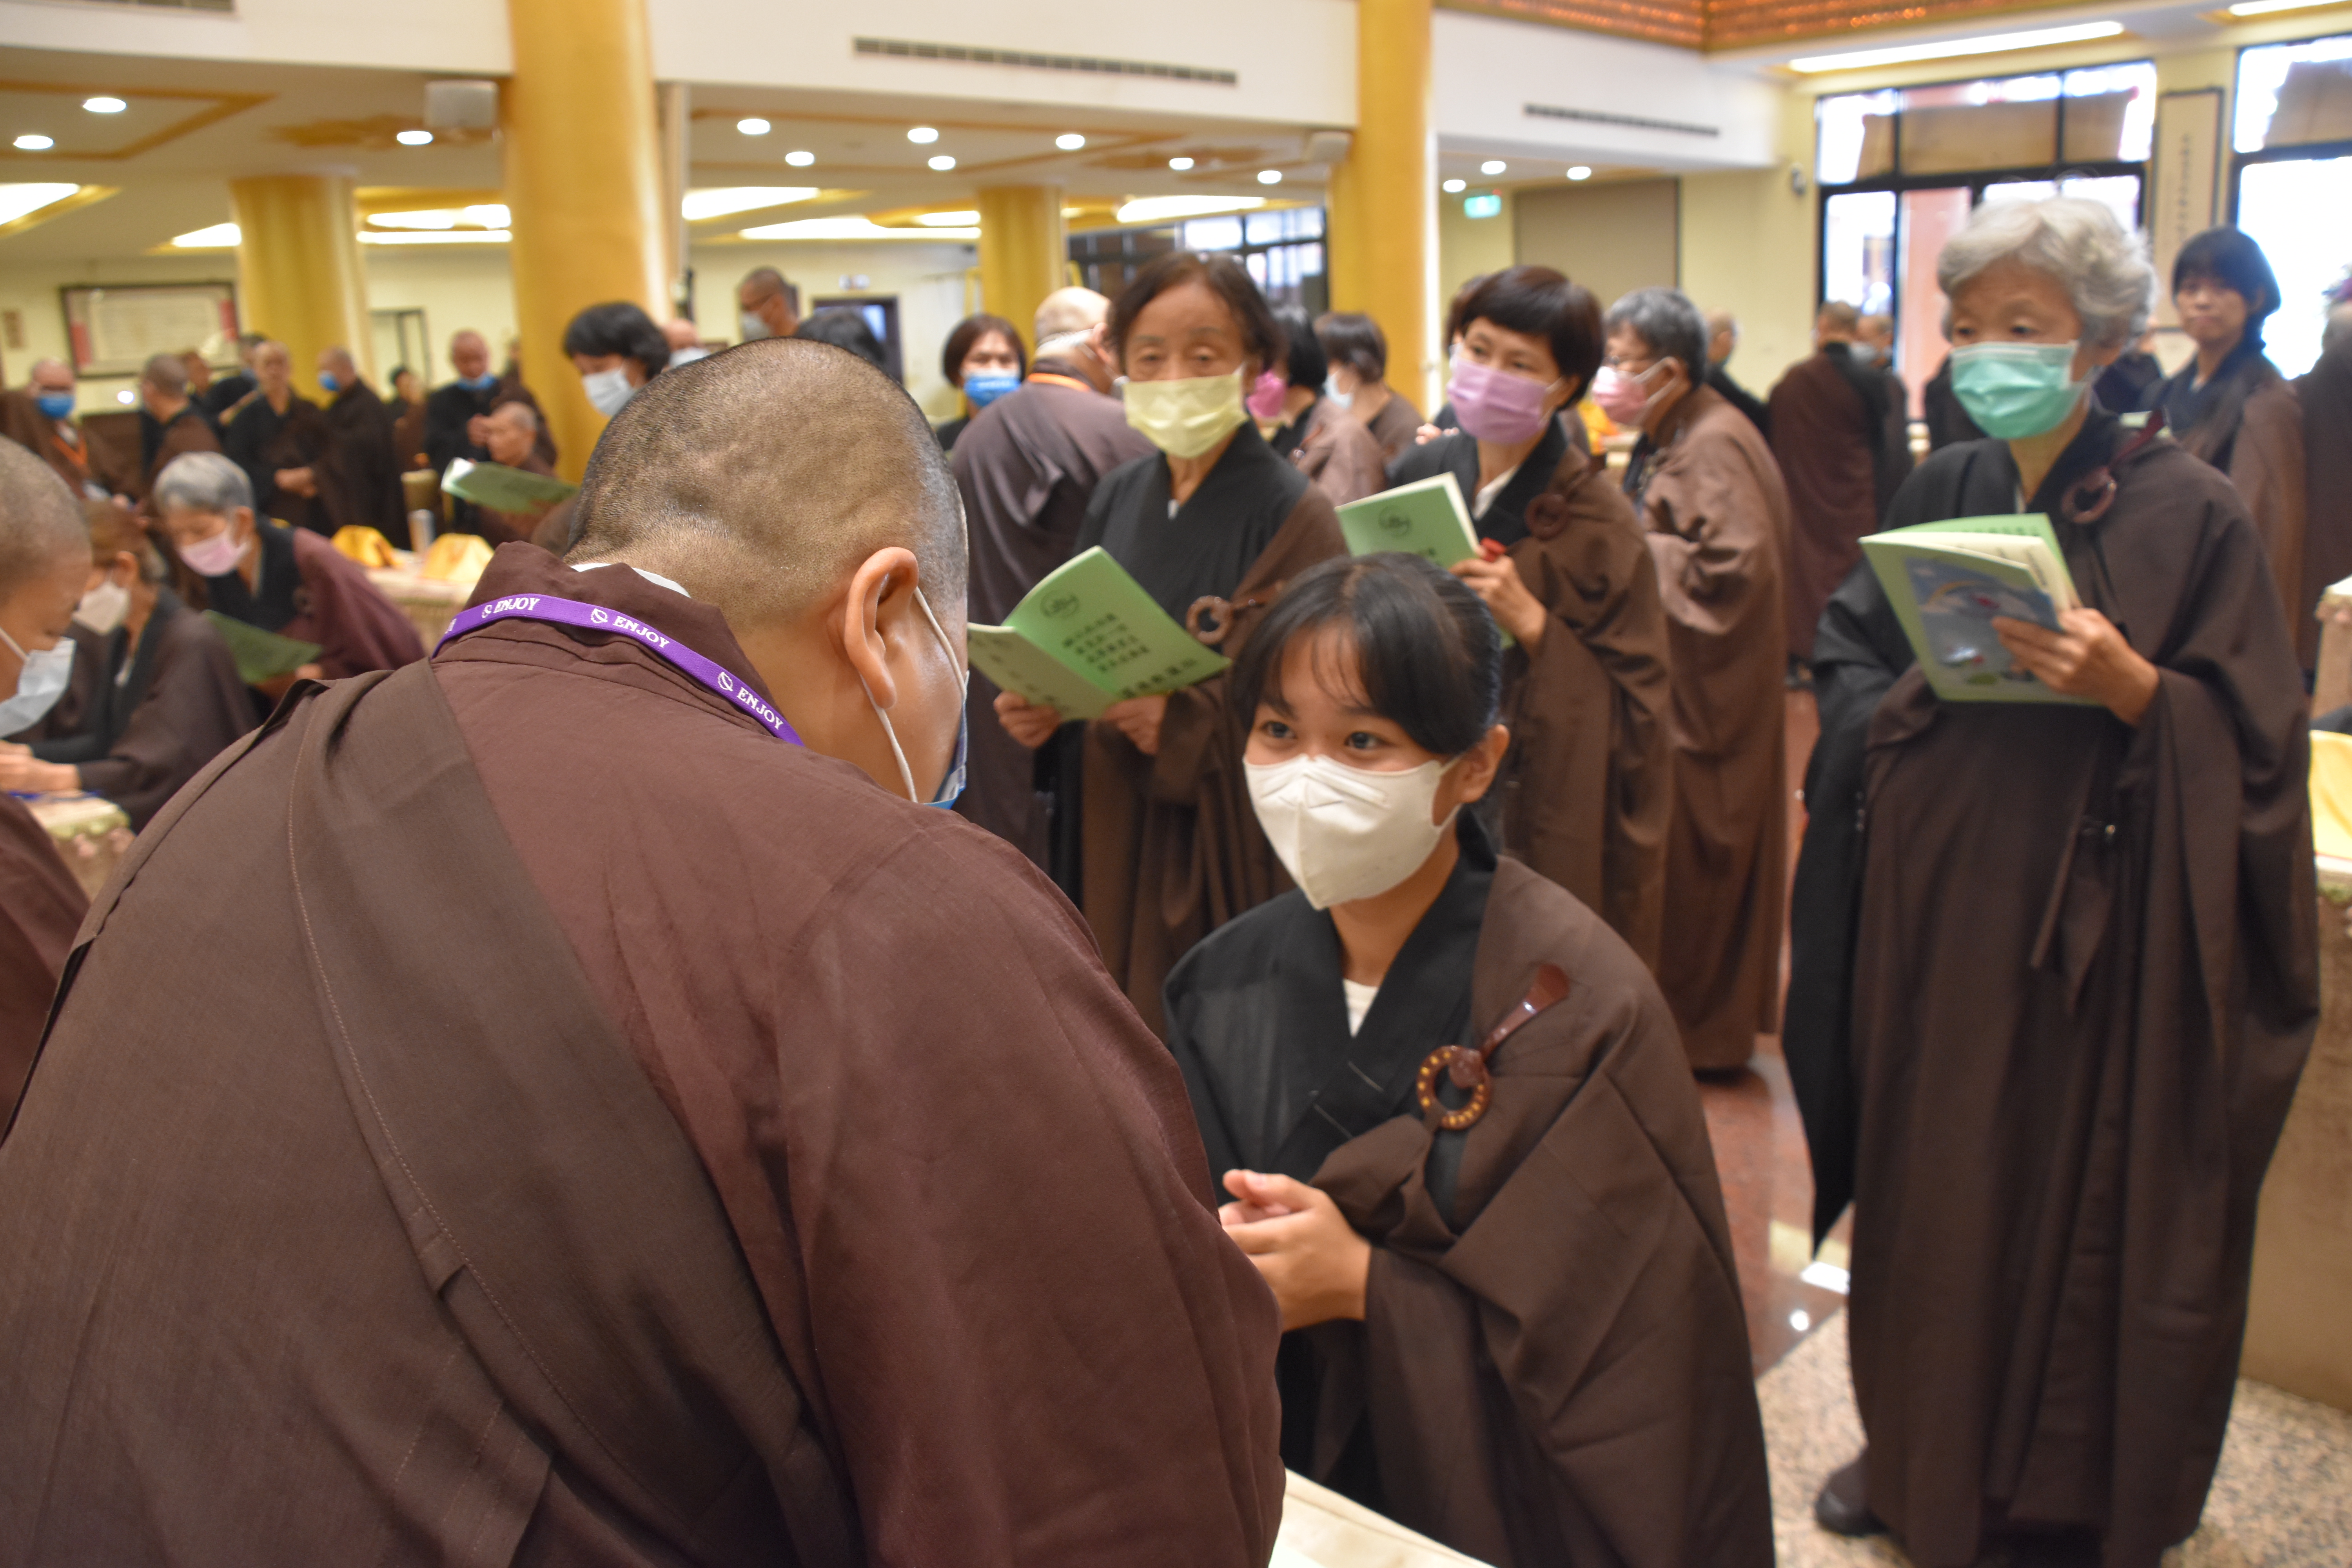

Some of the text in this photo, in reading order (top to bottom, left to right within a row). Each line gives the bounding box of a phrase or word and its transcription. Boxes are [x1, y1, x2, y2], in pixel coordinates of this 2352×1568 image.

[494, 597, 540, 613] ENJOY
[612, 615, 670, 648] ENJOY
[736, 686, 784, 730] ENJOY
